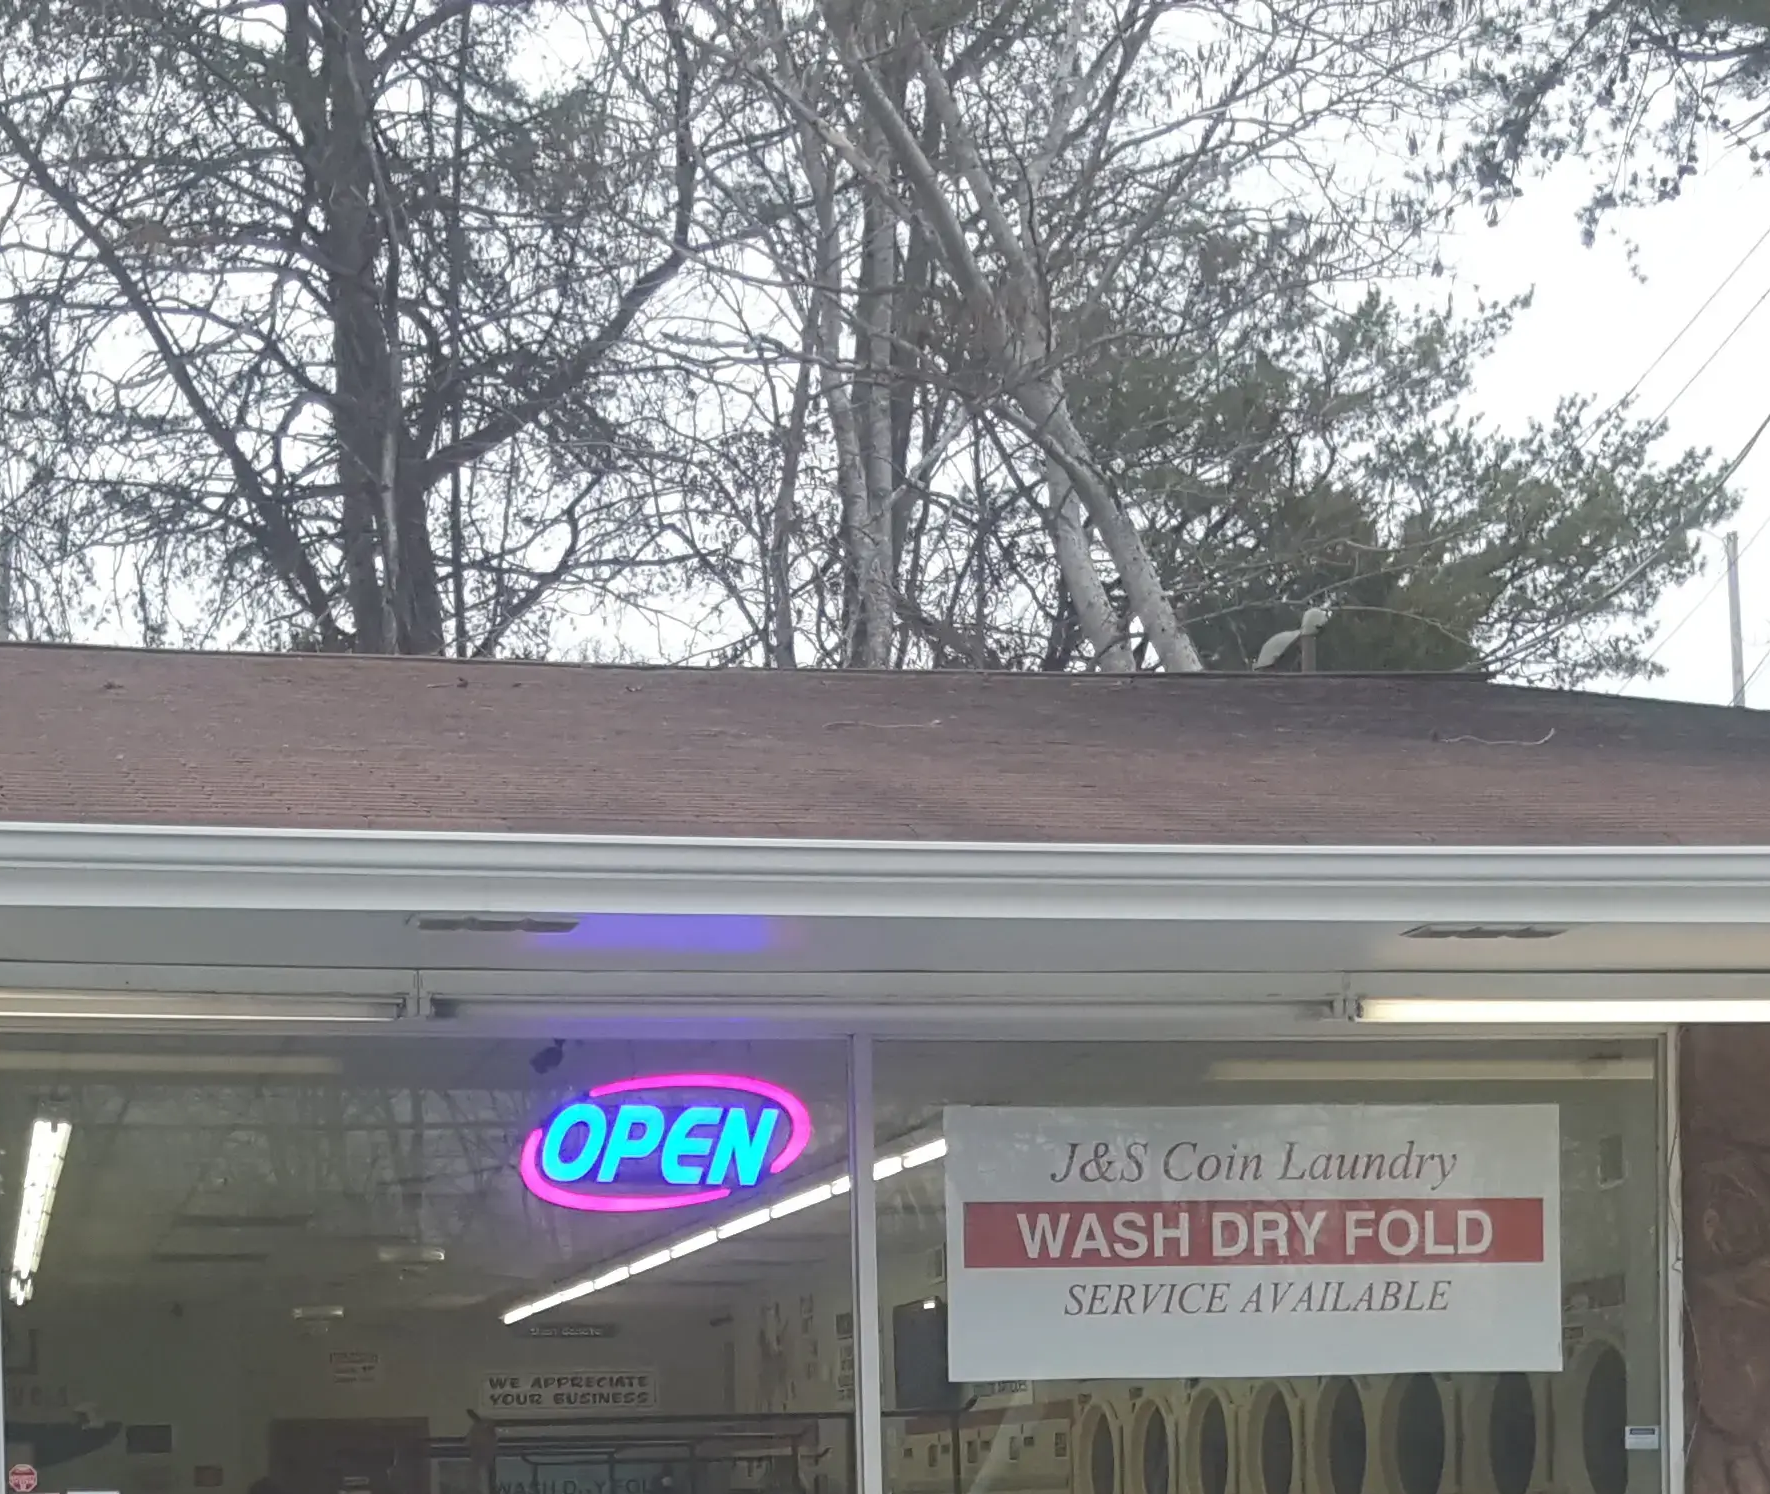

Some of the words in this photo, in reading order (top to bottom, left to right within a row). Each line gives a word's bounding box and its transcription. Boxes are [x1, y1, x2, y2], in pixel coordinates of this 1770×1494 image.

[541, 1102, 779, 1187] OPEN
[1050, 1141, 1149, 1183] J&S
[1163, 1141, 1263, 1181] Coin
[1279, 1140, 1458, 1190] Laundry
[1017, 1213, 1189, 1260] WASH
[1211, 1211, 1327, 1257] DRY
[1345, 1210, 1493, 1255] FOLD
[1064, 1282, 1230, 1316] SERVICE
[1240, 1279, 1451, 1313] AVAILABLE
[489, 1376, 521, 1389] WE
[530, 1376, 649, 1389] APPRECIATE
[489, 1393, 542, 1406] YOUR
[553, 1392, 649, 1405] BUSINESS
